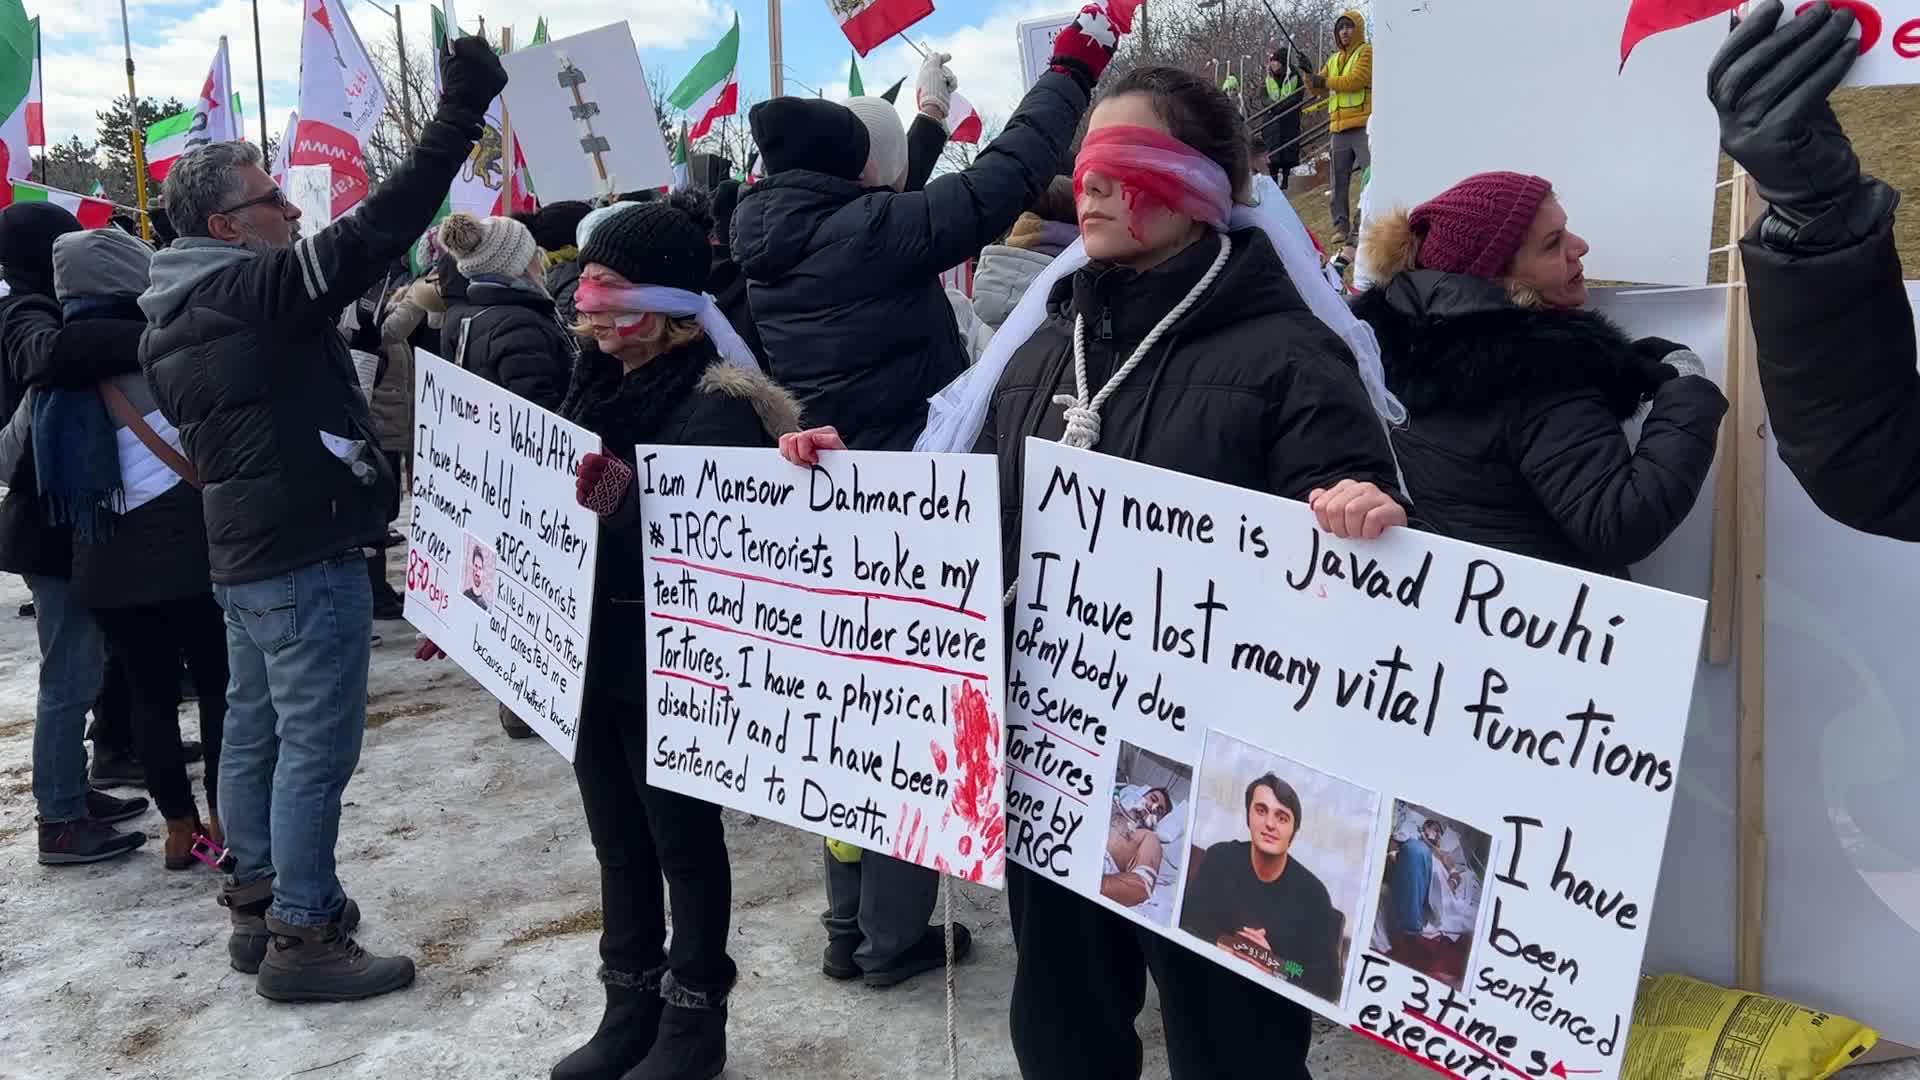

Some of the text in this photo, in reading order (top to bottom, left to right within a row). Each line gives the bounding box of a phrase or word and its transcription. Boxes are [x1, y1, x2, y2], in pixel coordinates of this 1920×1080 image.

[421, 369, 444, 424] My
[451, 394, 480, 424] name
[489, 403, 501, 434] is
[509, 404, 545, 467] Vahid
[417, 424, 427, 458] I
[430, 430, 450, 472] have
[455, 443, 478, 492] been
[481, 450, 513, 518] held
[520, 499, 531, 529] in
[643, 453, 970, 523] I am Mansour Dahmardeh
[411, 505, 452, 564] for over
[738, 514, 833, 578] terrorists
[854, 531, 926, 590] broke
[941, 558, 979, 613] my
[1038, 465, 1625, 666] My name is Javad Rouhi
[407, 548, 449, 613] 870 days
[532, 556, 576, 620] terrorists
[654, 571, 698, 612] teeth
[708, 581, 745, 625] and
[755, 602, 802, 640] nose
[490, 614, 567, 694] and arrested me
[503, 662, 517, 686] of
[526, 610, 541, 640] my
[545, 611, 583, 672] brother
[1015, 617, 1186, 731] of my body due
[1027, 552, 1673, 792] I have lost many vital functions
[738, 647, 754, 689] I
[765, 649, 805, 699] have
[816, 681, 832, 701] a
[842, 673, 948, 727] physical
[1010, 670, 1030, 710] to
[658, 681, 948, 800] disability and I have been
[764, 765, 787, 806] to
[1050, 796, 1083, 845] by
[1494, 815, 1639, 930] I have
[1488, 896, 1579, 985] been
[1402, 975, 1430, 1013] 3
[1475, 967, 1620, 1056] sentenced
